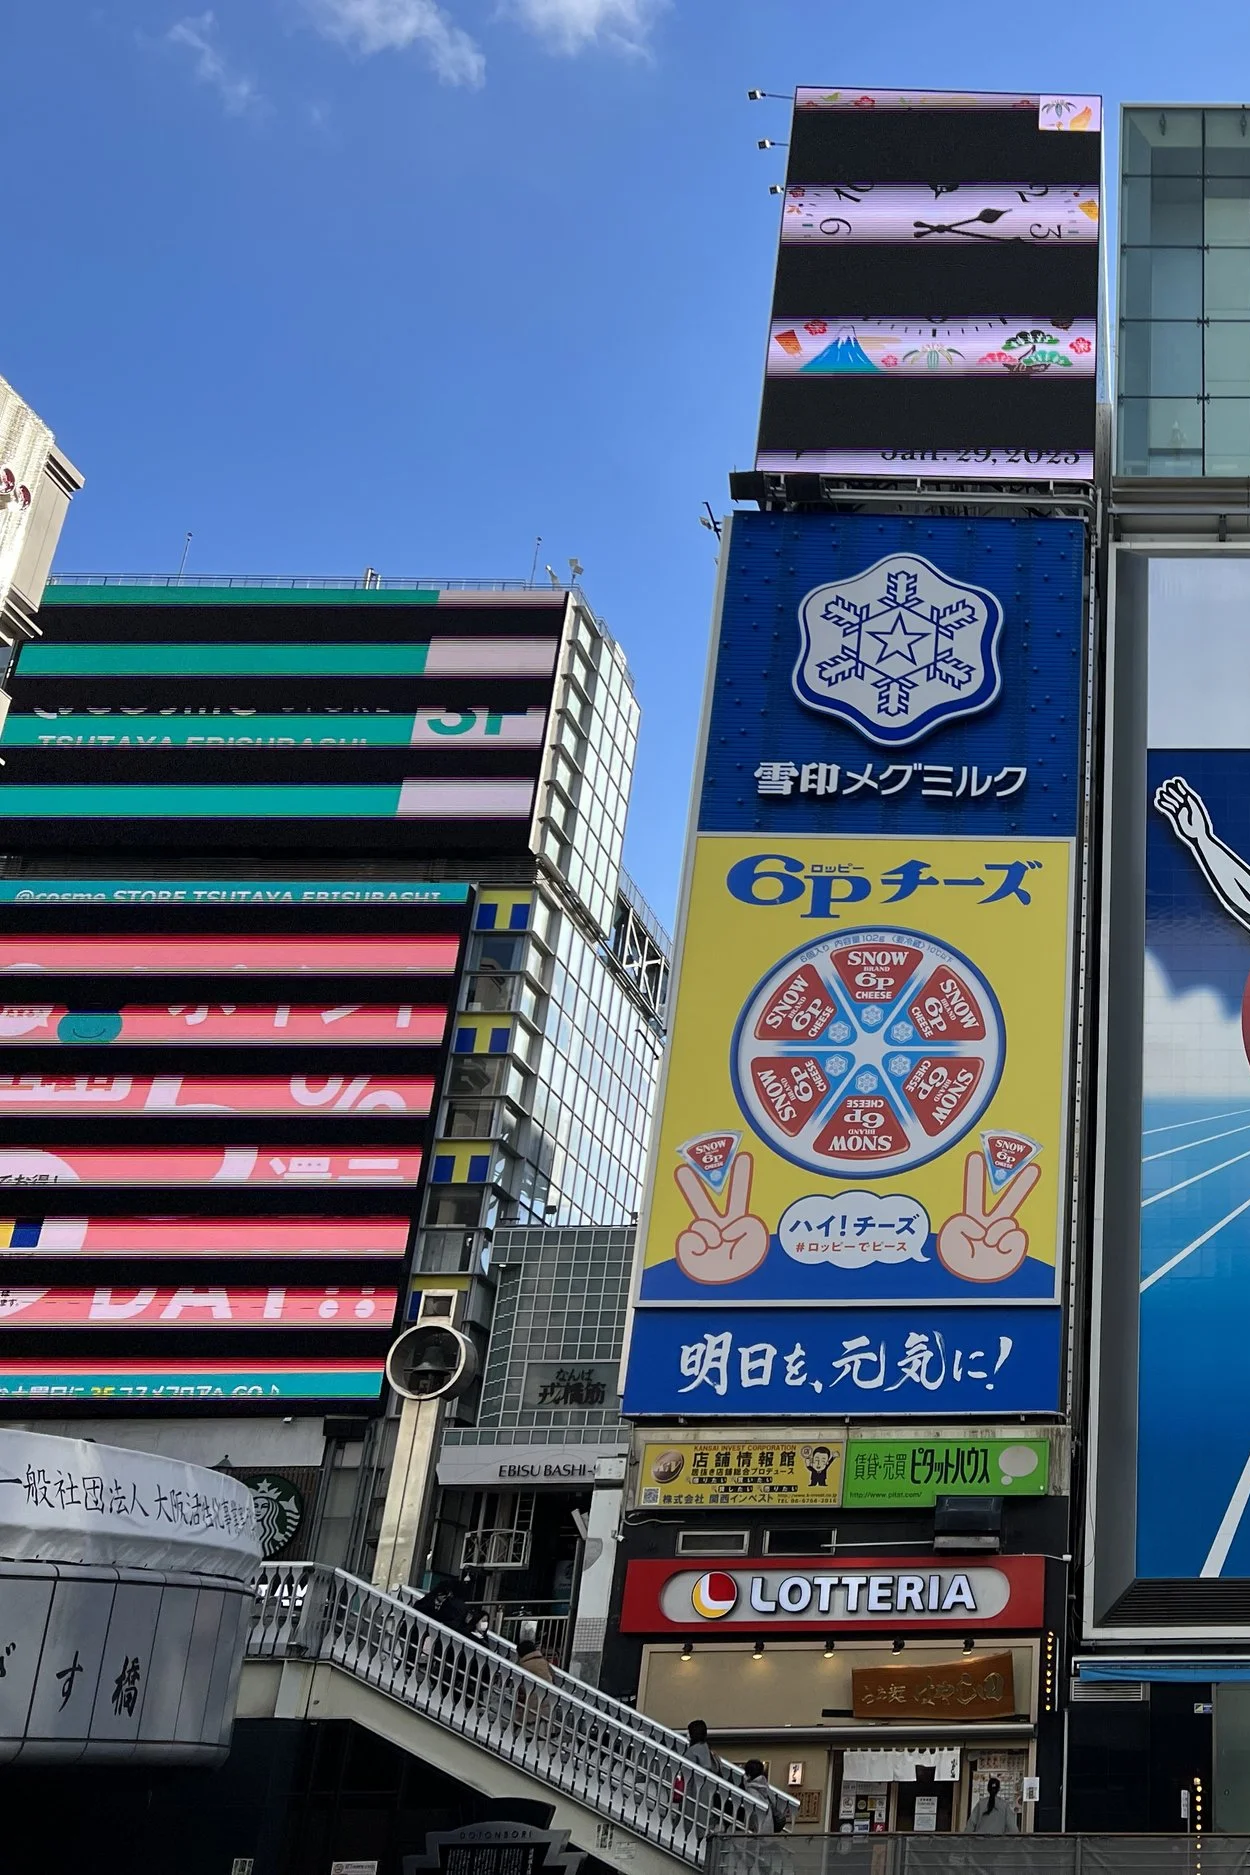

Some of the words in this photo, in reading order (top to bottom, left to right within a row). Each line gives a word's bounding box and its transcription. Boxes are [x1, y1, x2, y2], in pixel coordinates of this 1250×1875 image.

[753, 761, 1028, 799] 雪印メグミルク
[810, 863, 865, 874] ロッピー
[847, 951, 909, 967] SNOW
[863, 965, 890, 973] BRAND
[765, 974, 810, 1030] SNOW
[855, 991, 892, 1000] CHEESE
[938, 978, 980, 1030] SNOW
[788, 996, 808, 1020] BRAND
[941, 997, 956, 1022] BRAND
[807, 1004, 835, 1039] CHEESE
[911, 1006, 933, 1039] CHEESE
[805, 1059, 828, 1093] CHEESE
[905, 1059, 932, 1093] CHEESE
[757, 1068, 798, 1123] SNOW
[780, 1077, 796, 1102] BRAND
[931, 1067, 974, 1126] SNOW
[932, 1078, 952, 1103] BRAND
[846, 1099, 884, 1108] CHEESE
[695, 1139, 727, 1155] SNOW
[828, 1135, 893, 1152] SNOW
[995, 1139, 1026, 1153] SNOW
[554, 1367, 595, 1381] なんば
[538, 1383, 607, 1406] 戎橋筋
[498, 1463, 541, 1478] EBISU
[692, 1451, 797, 1468] 店舗情報館
[853, 1453, 907, 1481] 賃貸・売買
[910, 1447, 992, 1485] ピタットハウス
[691, 1468, 795, 1476] 居抜き店舗総合プロデュース
[662, 1494, 704, 1505] 株式会社
[708, 1493, 774, 1505] 関西インベスト
[749, 1573, 978, 1614] LOTTERIA
[460, 1830, 534, 1840] DOTONBORI
